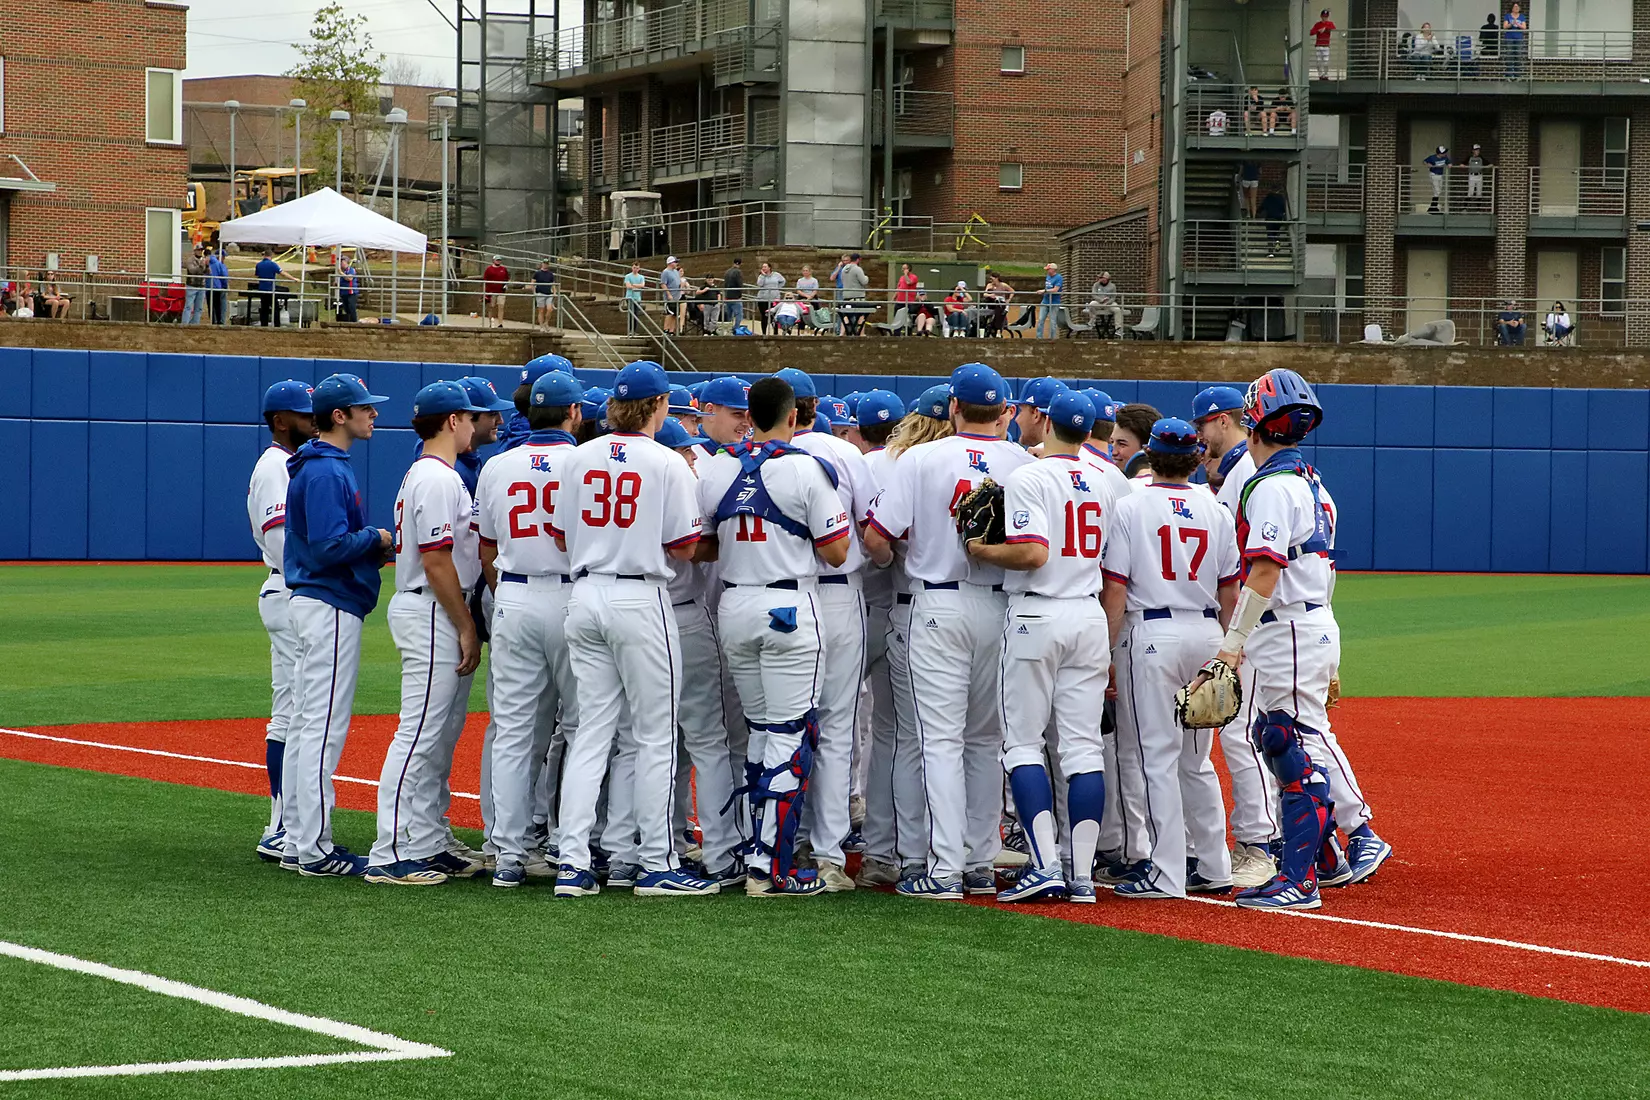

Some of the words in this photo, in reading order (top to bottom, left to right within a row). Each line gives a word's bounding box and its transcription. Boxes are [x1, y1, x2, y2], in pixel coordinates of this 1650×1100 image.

[581, 469, 643, 529] 38
[1061, 500, 1103, 559] 16
[1157, 524, 1209, 581] 17
